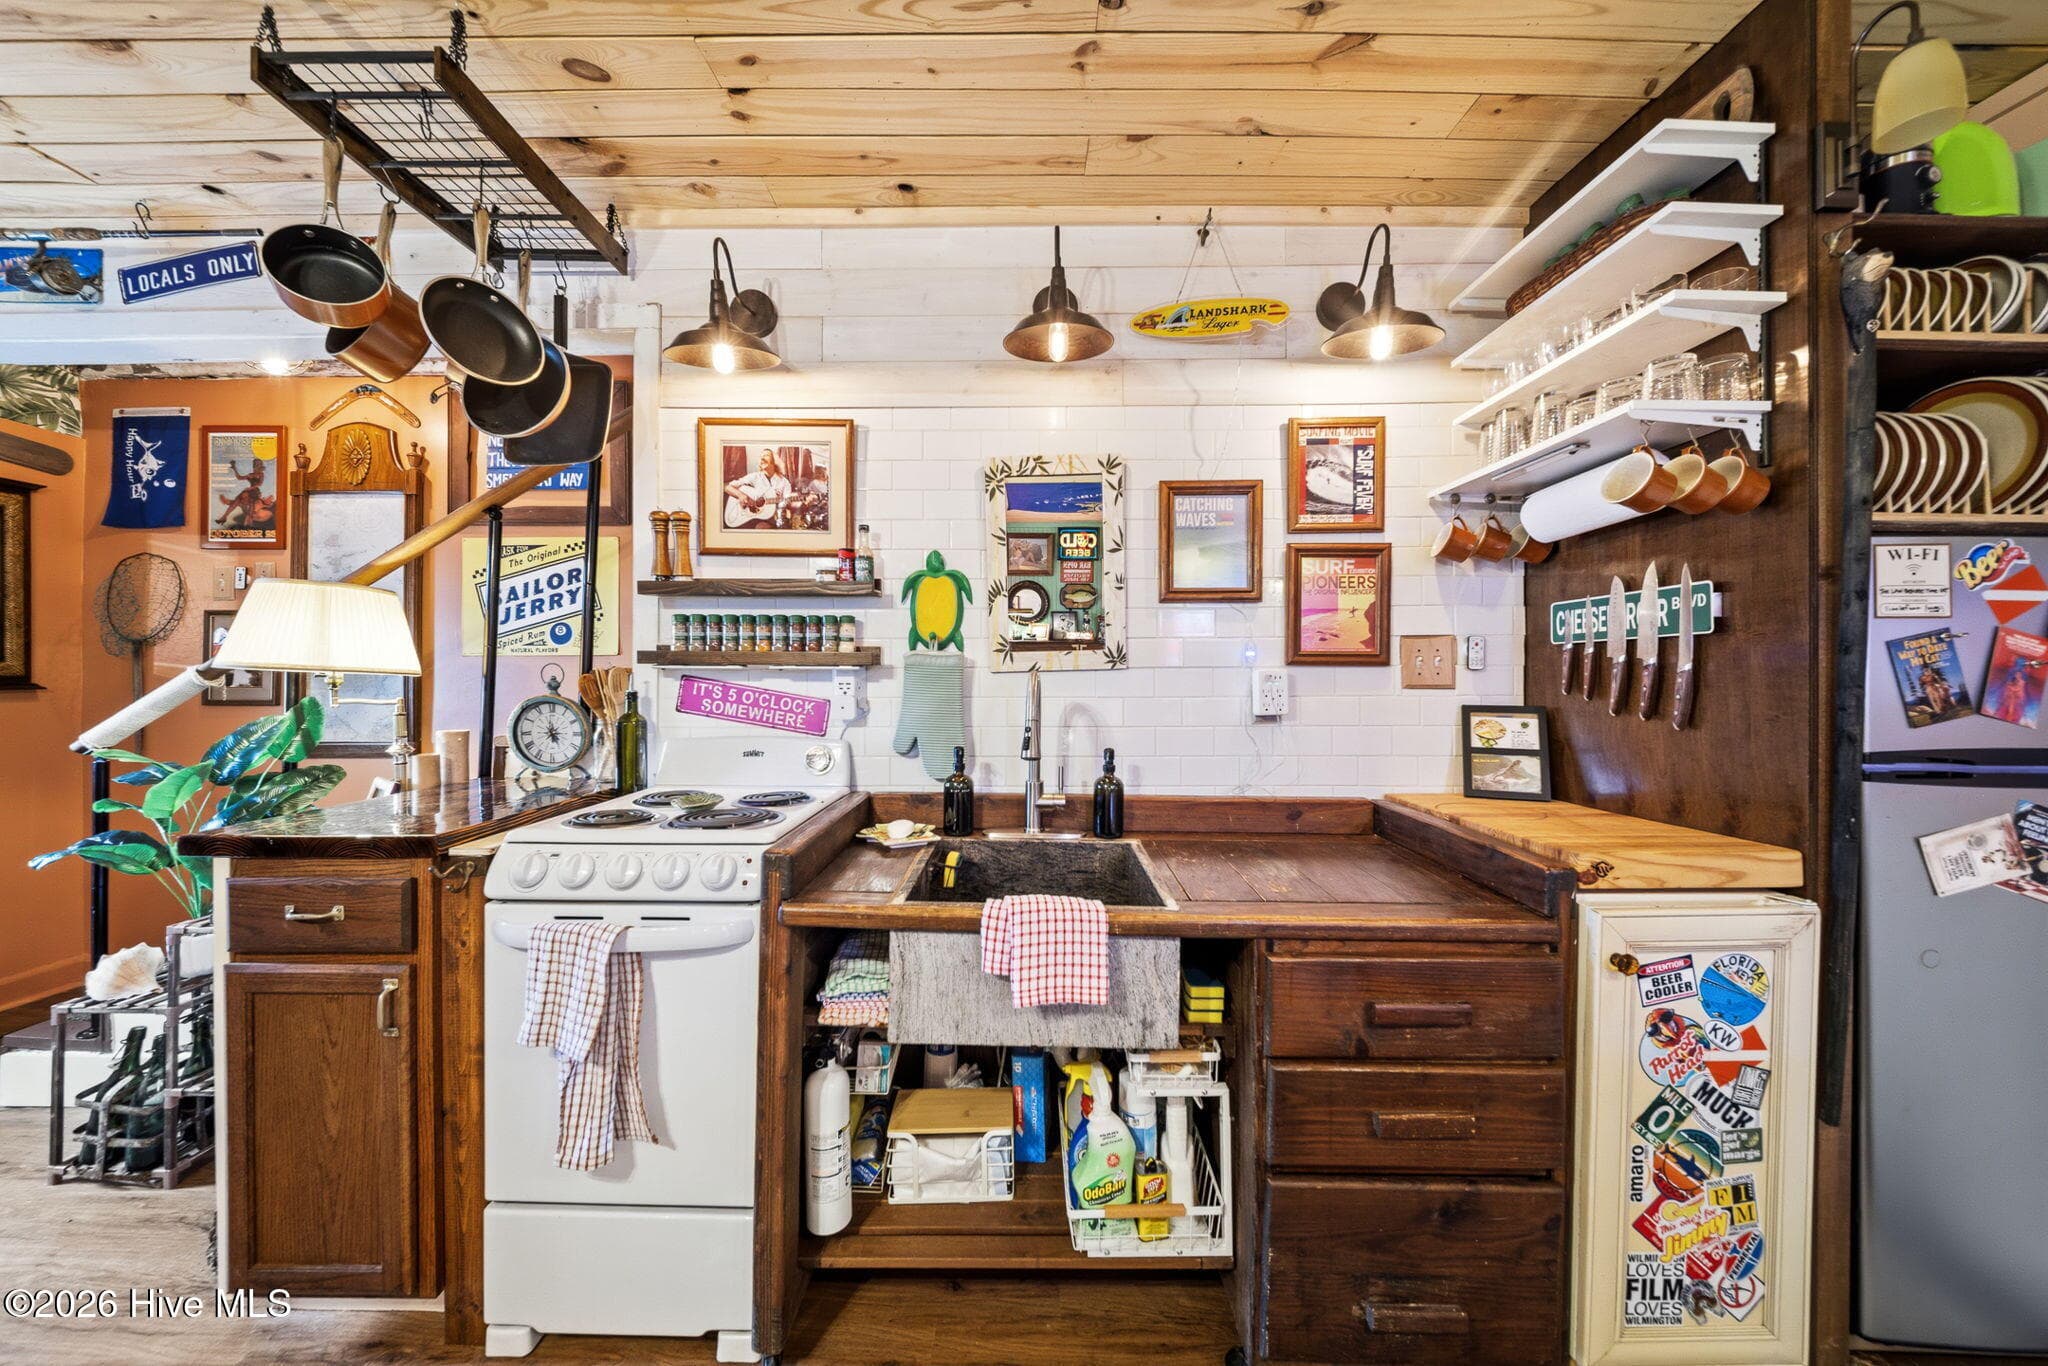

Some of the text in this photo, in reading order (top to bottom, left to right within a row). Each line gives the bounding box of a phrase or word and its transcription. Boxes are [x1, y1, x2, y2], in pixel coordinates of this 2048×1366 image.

[127, 252, 255, 295] LOCALS ONLY
[1189, 303, 1267, 319] LANDSHARK
[1202, 317, 1240, 331] Lager
[125, 428, 138, 483] Happy Hour
[560, 472, 583, 487] WAY
[1175, 496, 1234, 512] CATCHING
[1175, 512, 1216, 527] WAVES
[509, 546, 561, 568] The Original
[1887, 547, 1939, 560] WI-FI
[1303, 560, 1355, 575] SURF
[1303, 575, 1376, 589] PIONEERS
[500, 586, 583, 625] JERRY
[1671, 593, 1707, 610] BVD
[497, 636, 524, 650] Spiced
[528, 630, 546, 641] Rum
[692, 682, 816, 715] IT'S 5 O'CLOCK
[700, 698, 807, 729] SOMEWHERE
[742, 749, 765, 758] SUMMIT
[1645, 958, 1685, 973] ATTENTION
[1713, 956, 1765, 981] FLORIDA
[1651, 972, 1683, 988] BEER
[1735, 967, 1755, 985] KEYS
[1645, 981, 1693, 1000] COOLER
[1709, 1023, 1737, 1047] KW
[1649, 1030, 1695, 1075] Parrot
[1668, 1045, 1704, 1085] Head
[1661, 1086, 1694, 1116] MILE
[1692, 1081, 1754, 1129] MUCK
[1630, 1145, 1644, 1202] amaro
[1084, 1180, 1126, 1200] OdoBan
[1660, 1212, 1728, 1263] Jimmy
[1627, 1263, 1684, 1277] LOVES
[1626, 1279, 1683, 1300] FILM
[1625, 1301, 1682, 1316] LOVES
[1625, 1317, 1682, 1325] WILMINGTON
